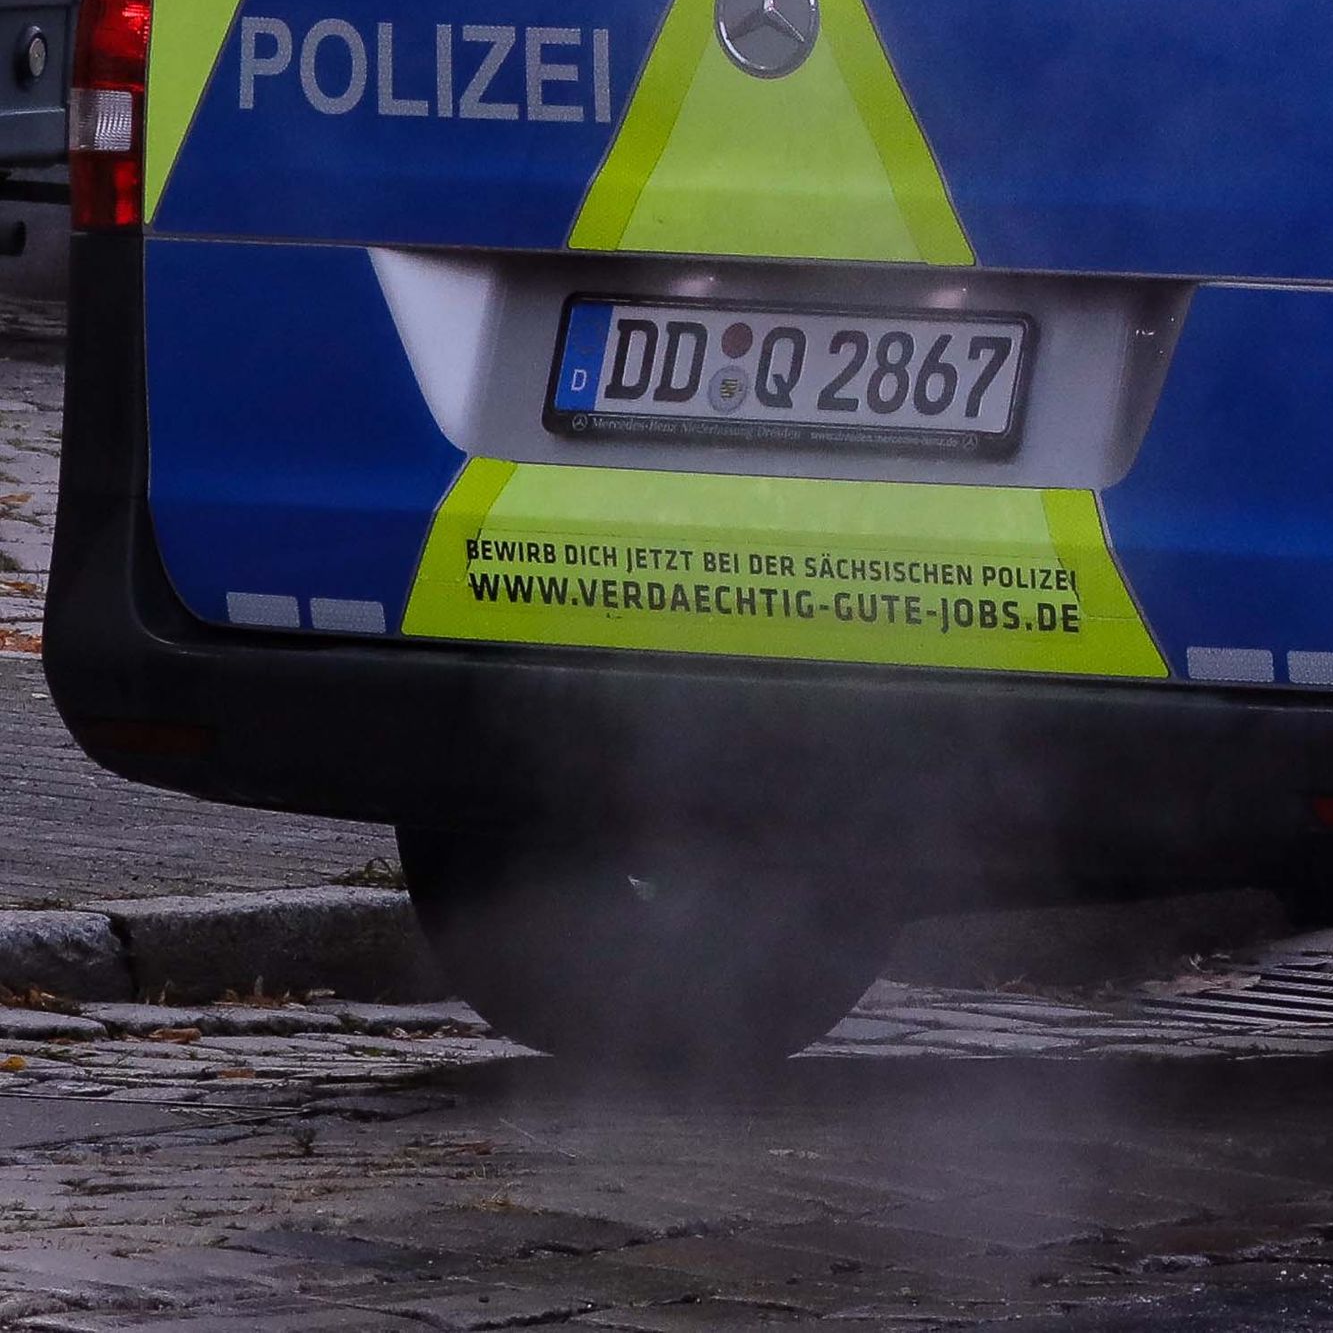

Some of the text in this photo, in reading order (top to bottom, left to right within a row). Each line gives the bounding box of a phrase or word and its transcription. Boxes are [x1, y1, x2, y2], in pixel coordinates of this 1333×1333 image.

[238, 16, 612, 123] POLIZEI
[570, 368, 588, 392] D
[604, 318, 1012, 418] DD Q 2867
[466, 539, 1077, 591] BEWIRB DICH JETZT BEI DER SÄCHSISCHEN POLIZEI
[469, 572, 1081, 633] WWW.VERDAECHTIG-GUTE-JOBS.DE
